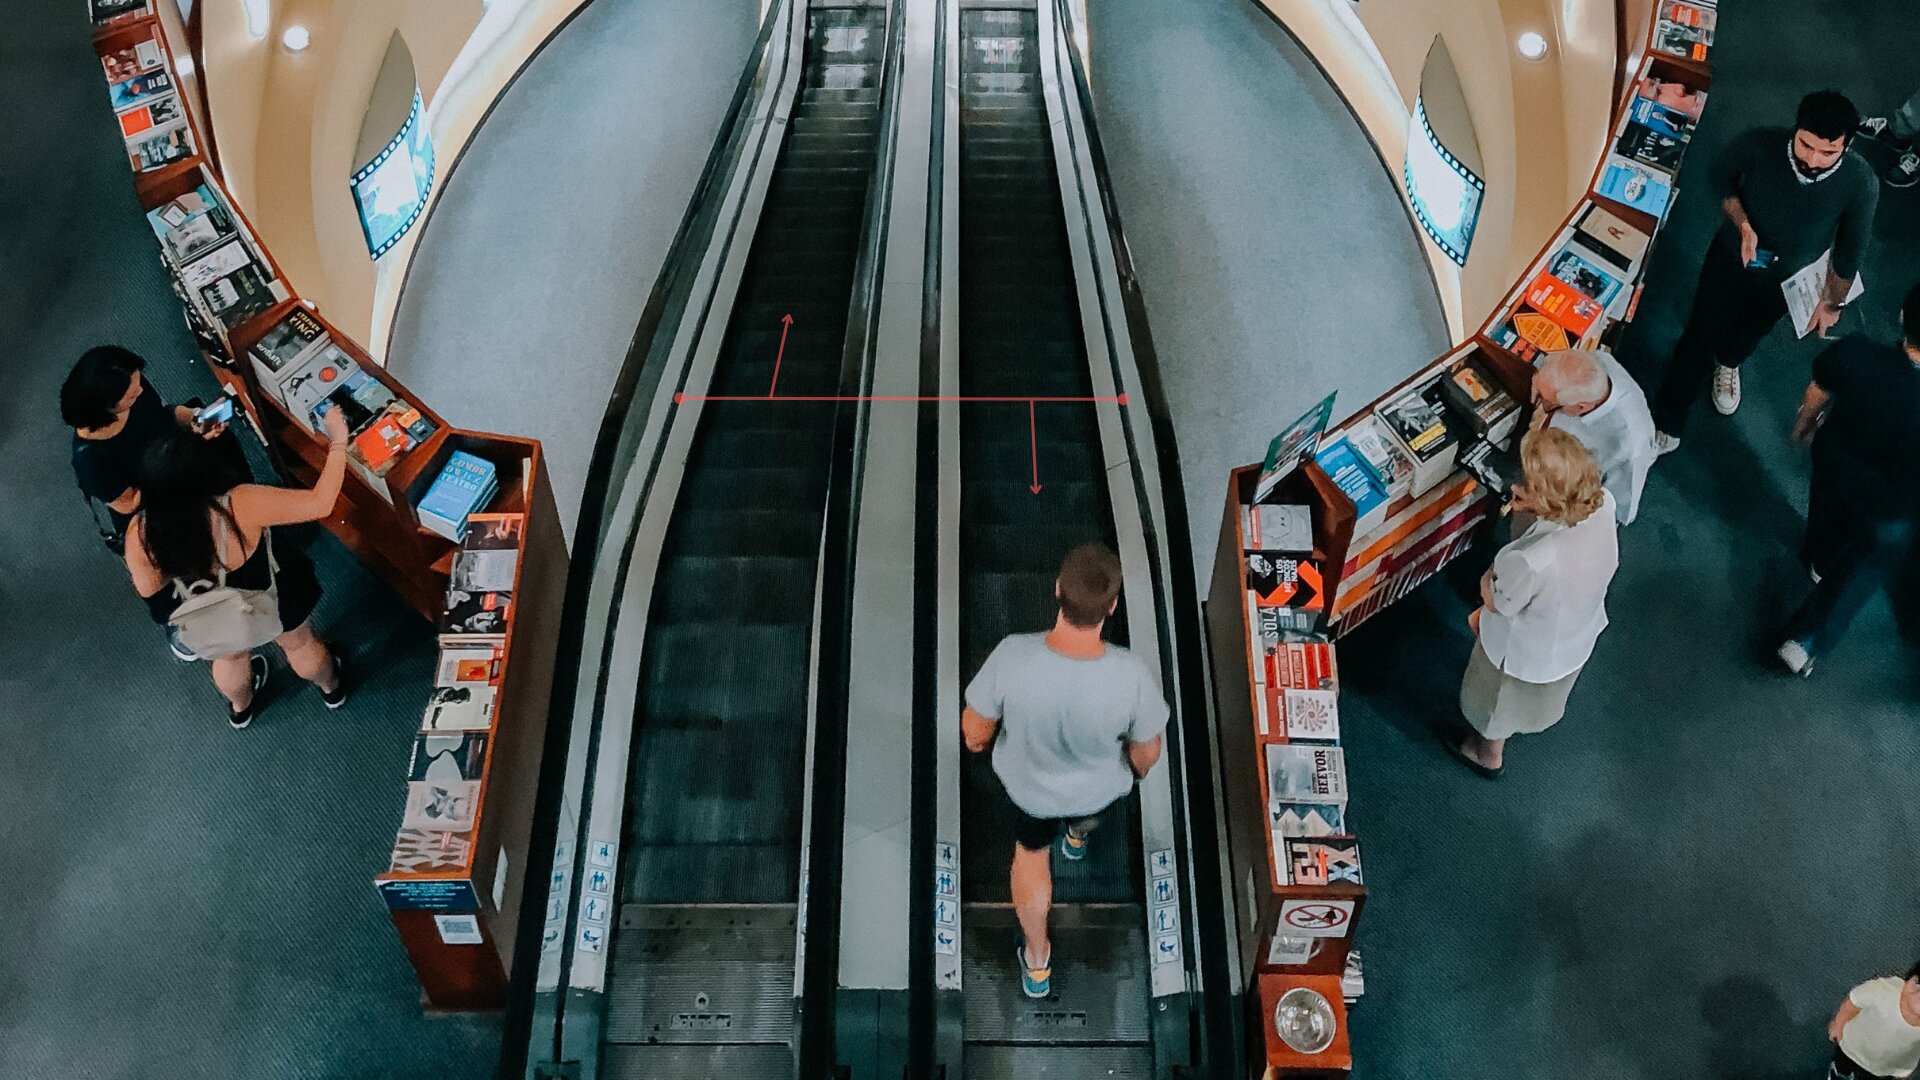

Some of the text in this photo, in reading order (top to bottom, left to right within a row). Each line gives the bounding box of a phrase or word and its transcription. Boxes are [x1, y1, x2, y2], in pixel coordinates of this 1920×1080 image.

[289, 316, 315, 340] KING
[440, 472, 477, 491] TEATRO
[1276, 559, 1284, 574] LOS
[1314, 750, 1329, 794] BEEVOR
